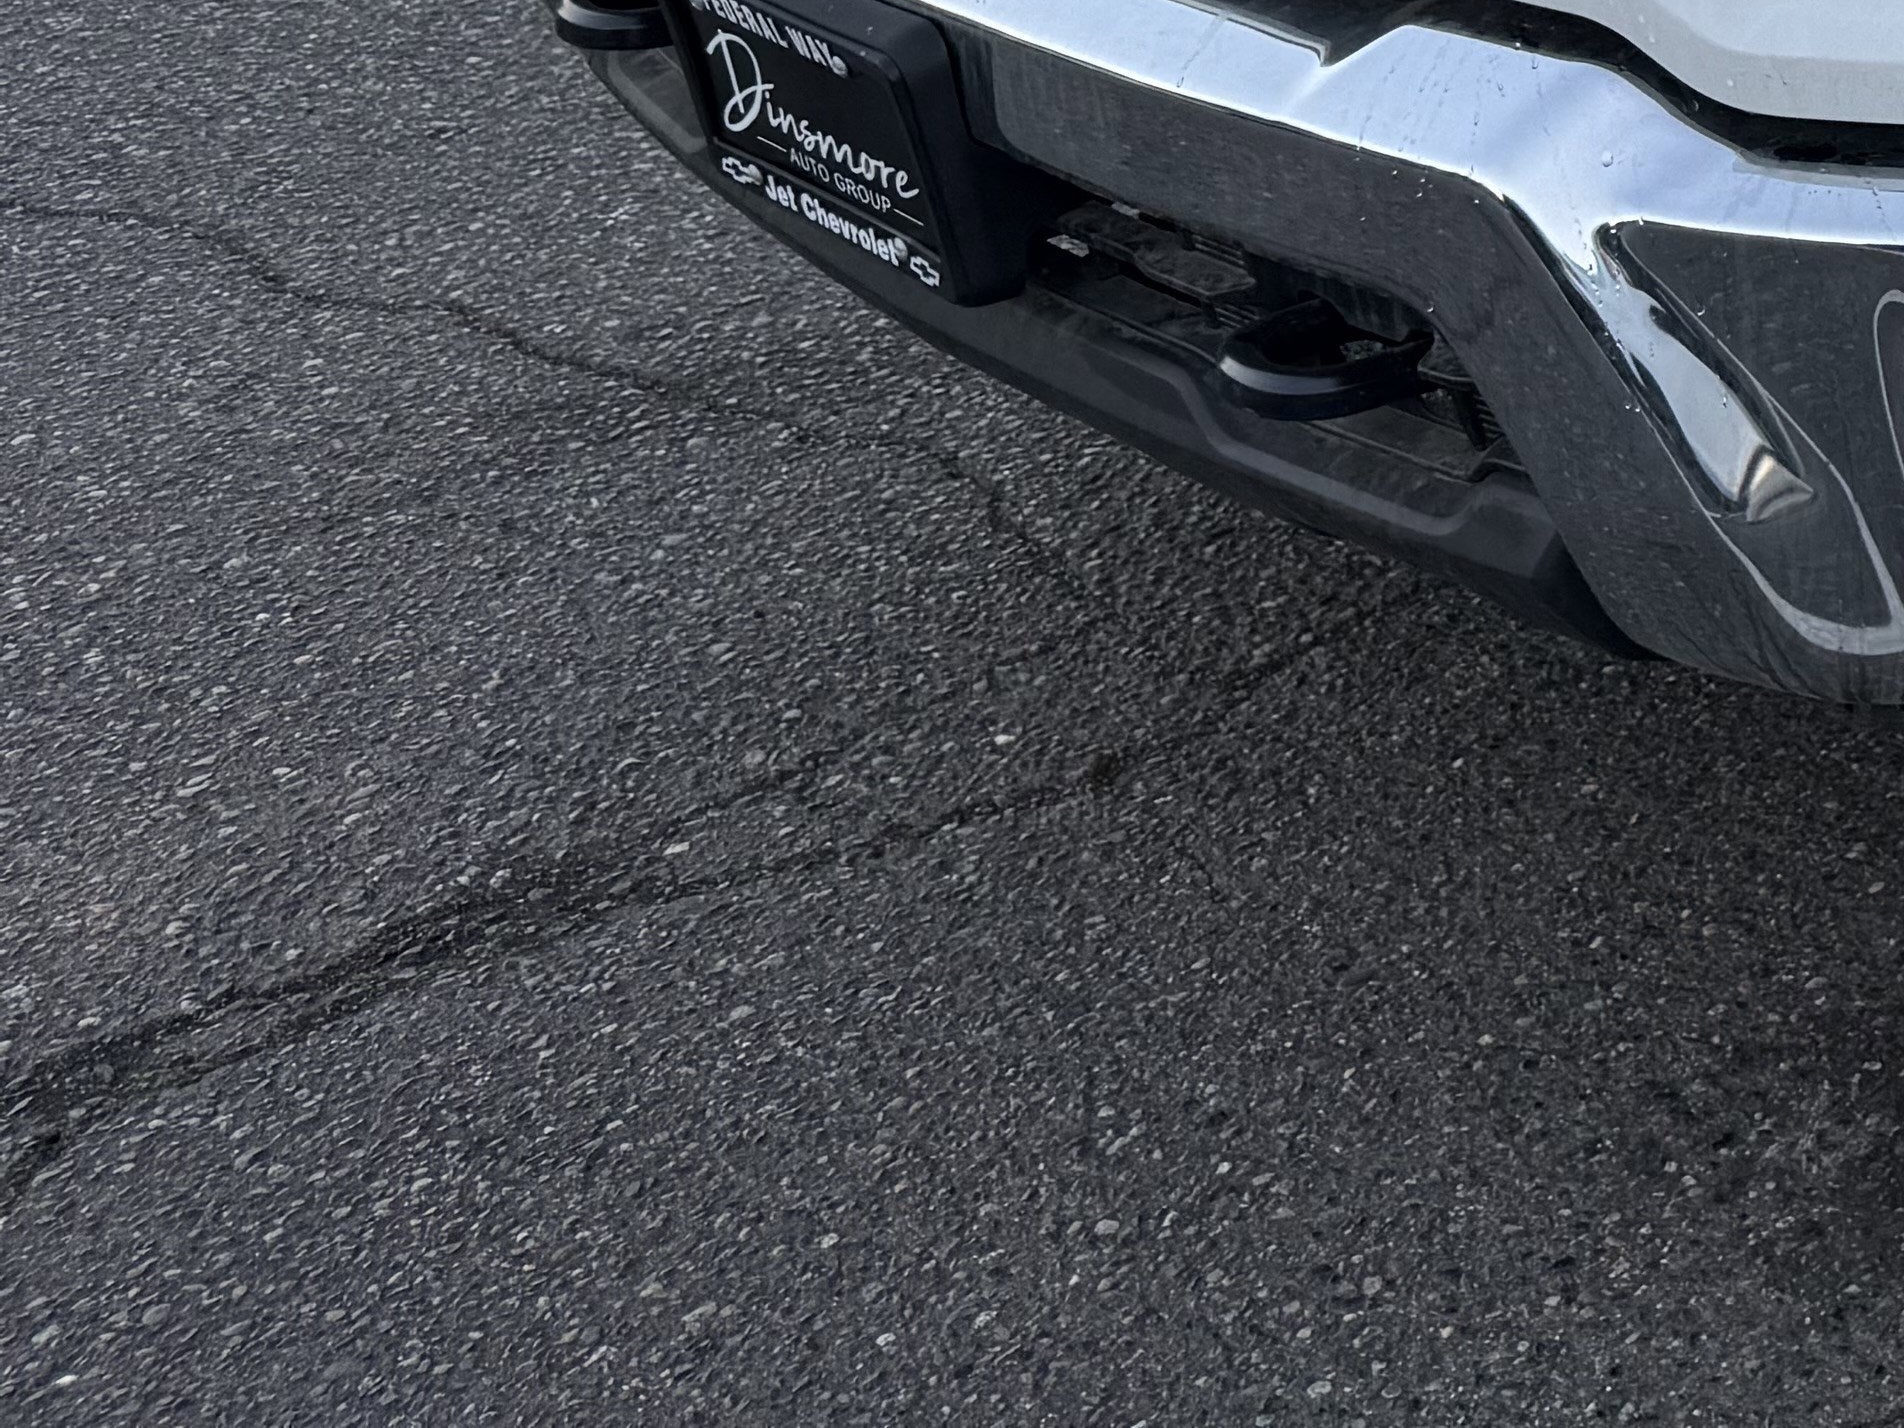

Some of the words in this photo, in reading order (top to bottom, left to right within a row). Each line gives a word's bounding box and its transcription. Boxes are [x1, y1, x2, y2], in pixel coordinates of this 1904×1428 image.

[705, 29, 920, 199] Dinsmore
[765, 174, 798, 213] Jet
[799, 192, 902, 267] Chevrolet
[789, 147, 830, 183] AUTO
[833, 172, 892, 214] GROUP
